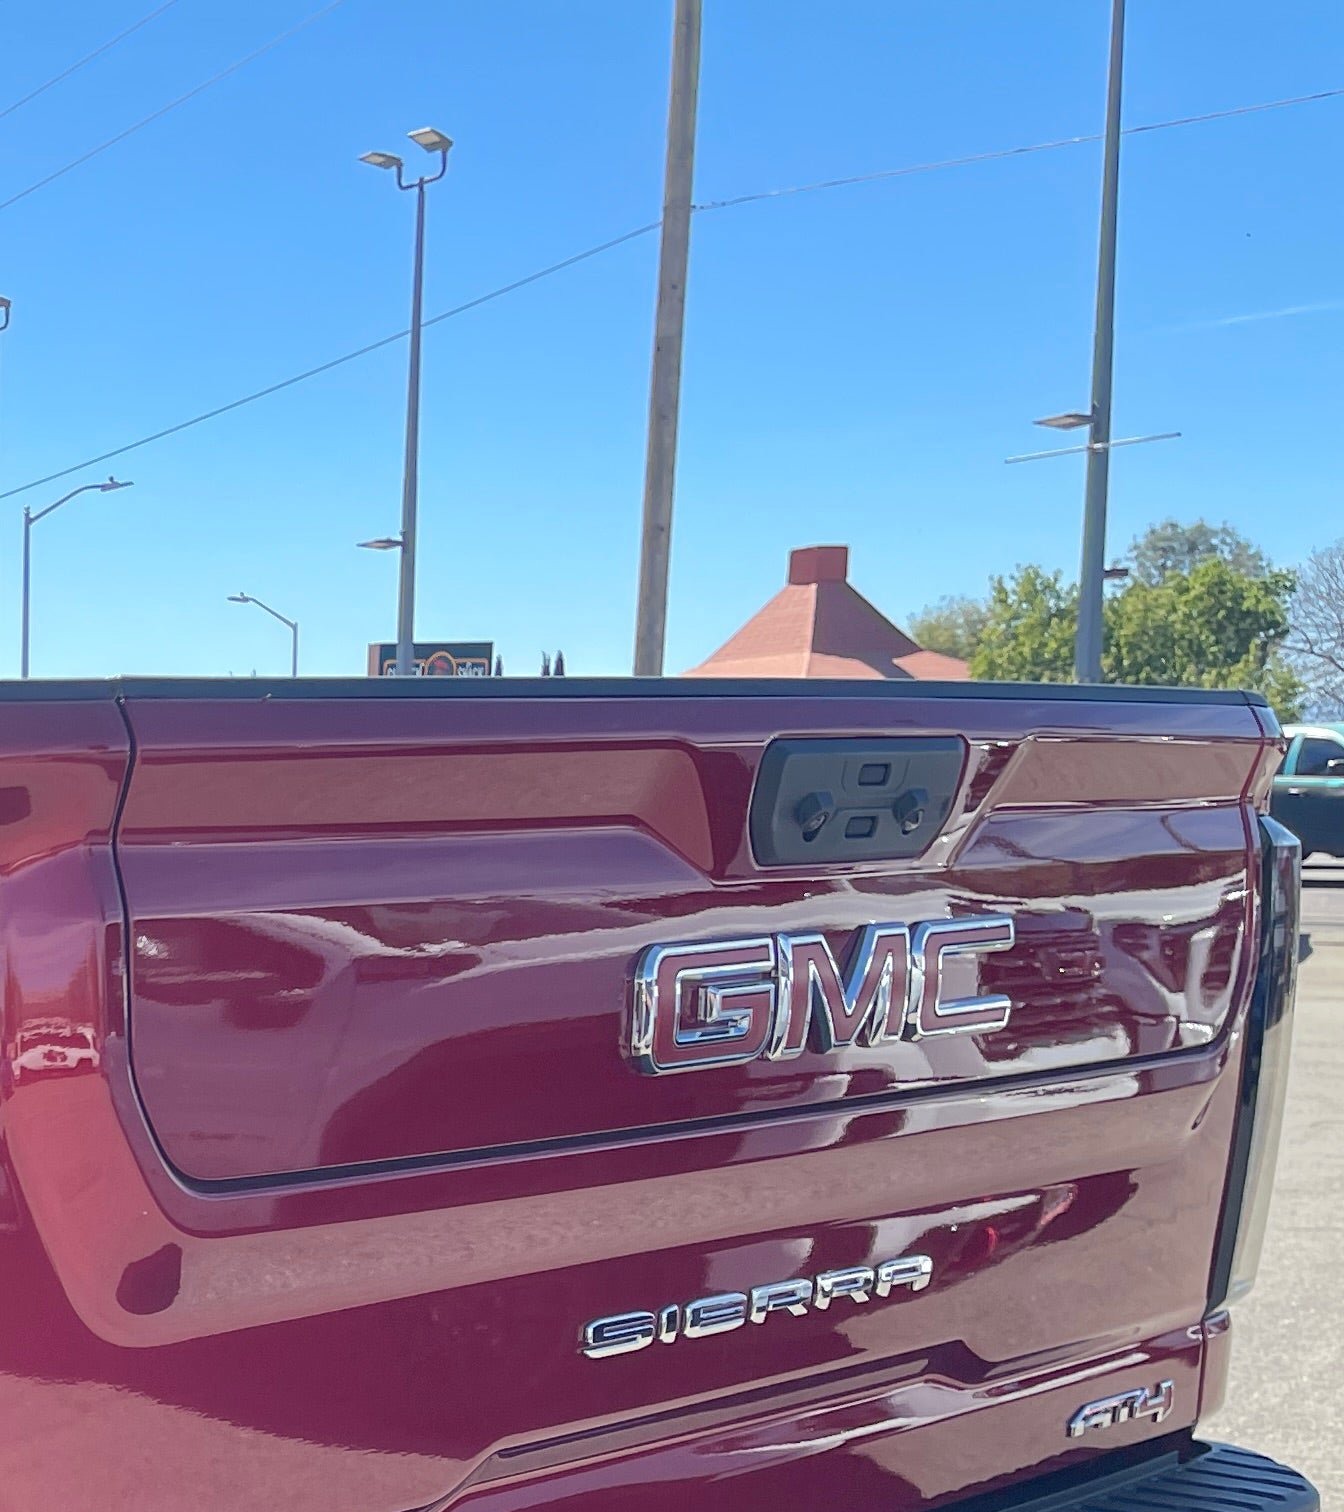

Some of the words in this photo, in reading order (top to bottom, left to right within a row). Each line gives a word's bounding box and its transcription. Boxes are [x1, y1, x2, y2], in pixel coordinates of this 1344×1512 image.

[623, 917, 1015, 1076] GMC
[578, 1255, 933, 1360] SIERRA
[1066, 1380, 1176, 1439] AT4
